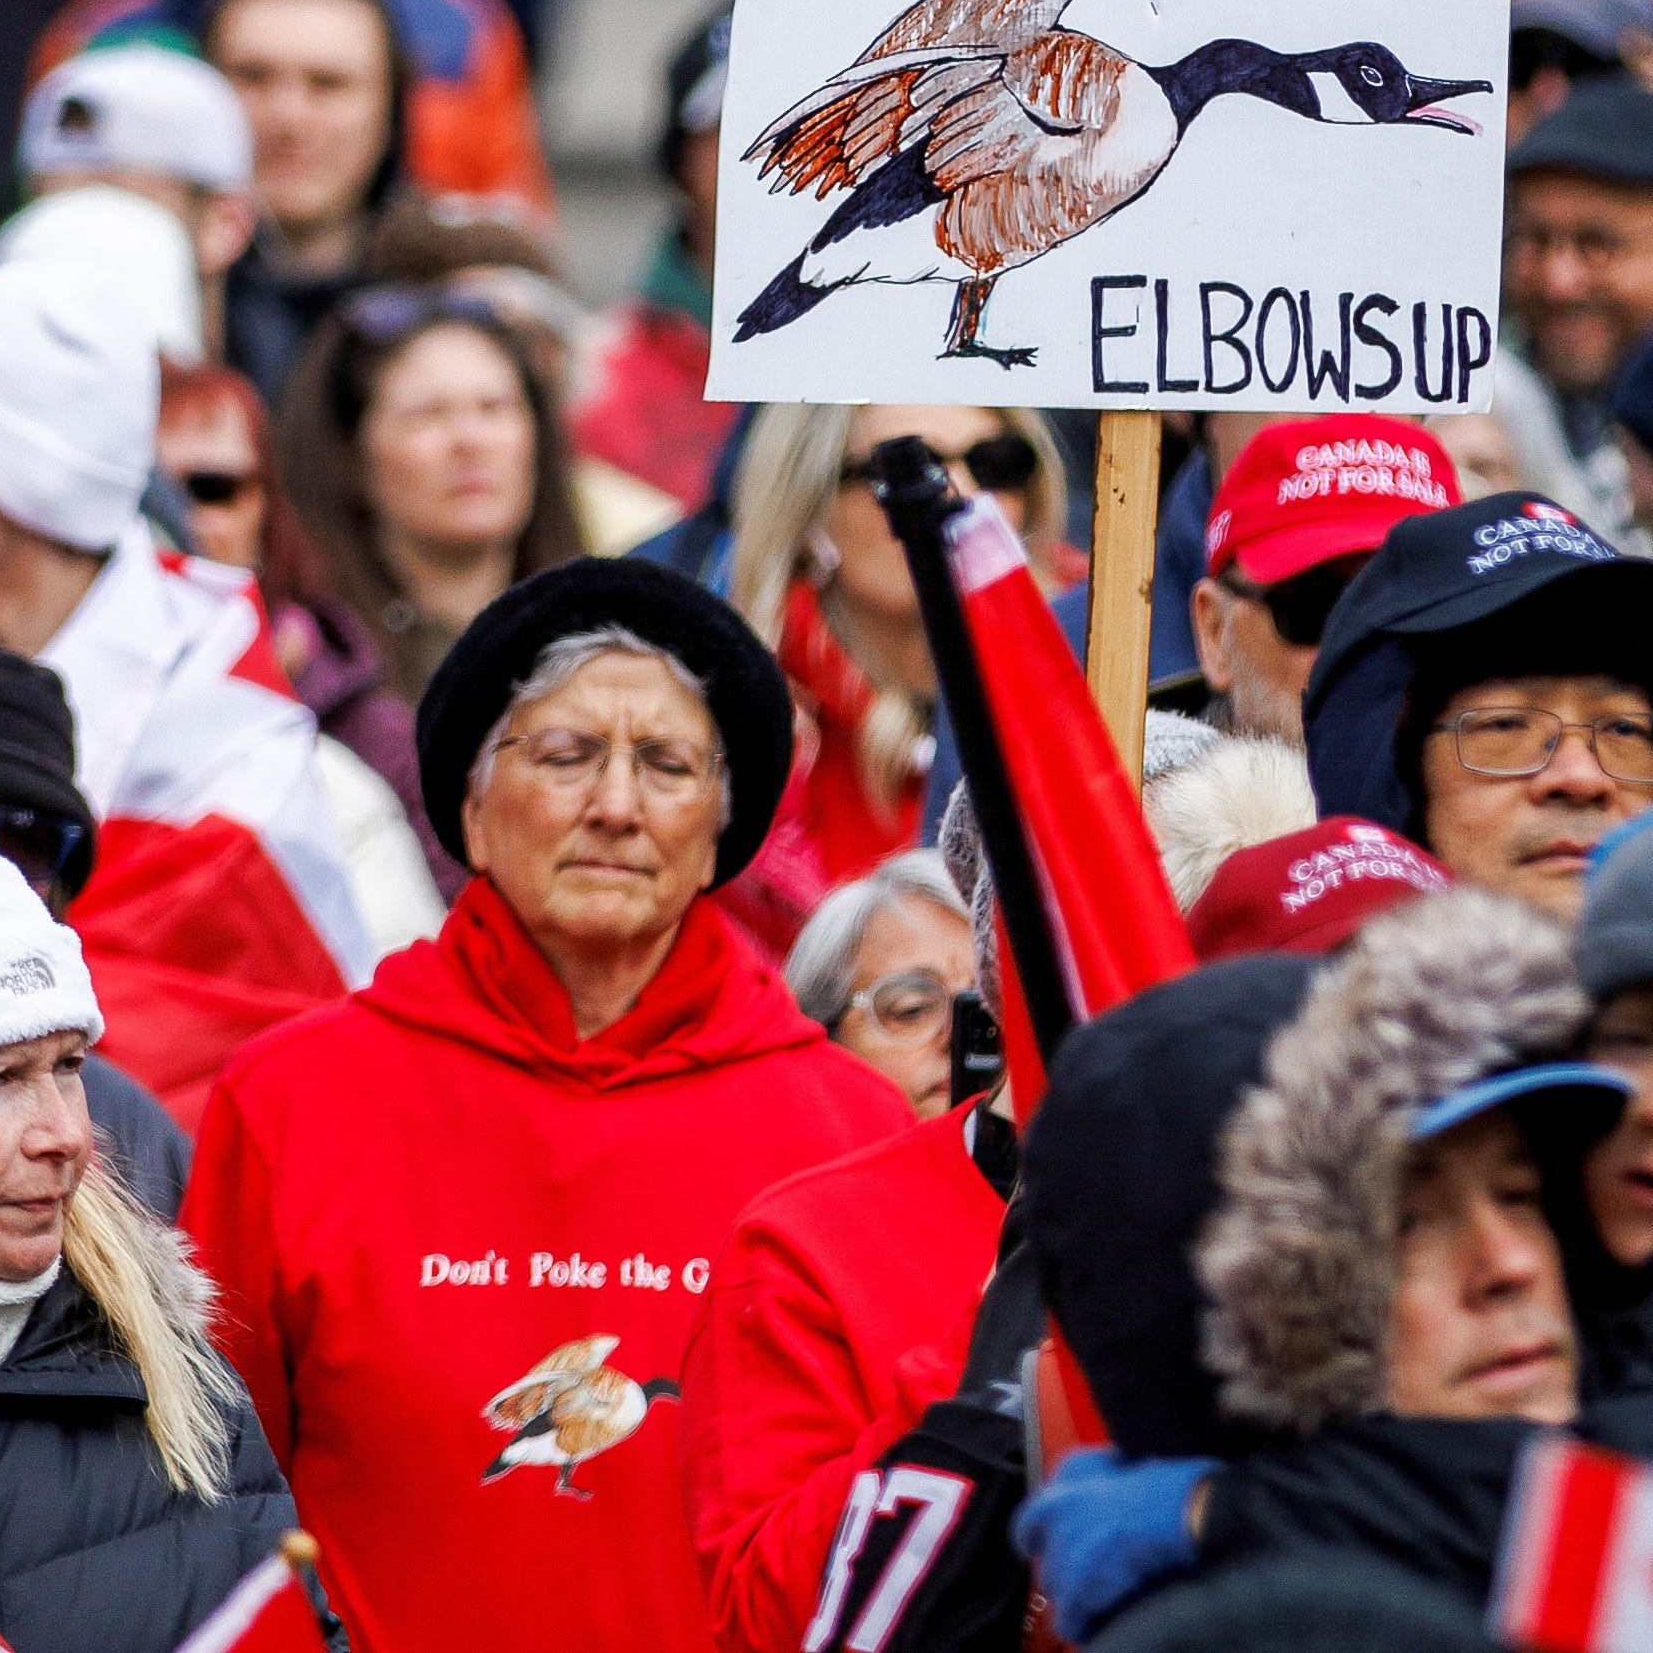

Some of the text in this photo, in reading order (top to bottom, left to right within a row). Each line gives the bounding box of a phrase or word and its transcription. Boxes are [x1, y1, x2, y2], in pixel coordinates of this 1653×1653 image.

[1092, 274, 1491, 403] ELBOWS UP
[1296, 438, 1411, 471] CANADA
[1276, 467, 1336, 505] NOT
[1338, 466, 1395, 495] FOR
[1467, 538, 1530, 575] NOT
[1533, 535, 1591, 557] FOR
[1289, 842, 1422, 882] CANADA
[1281, 859, 1404, 914] NOT FOR
[420, 1249, 509, 1287] Don't
[529, 1252, 607, 1289] Poke
[620, 1253, 671, 1291] the
